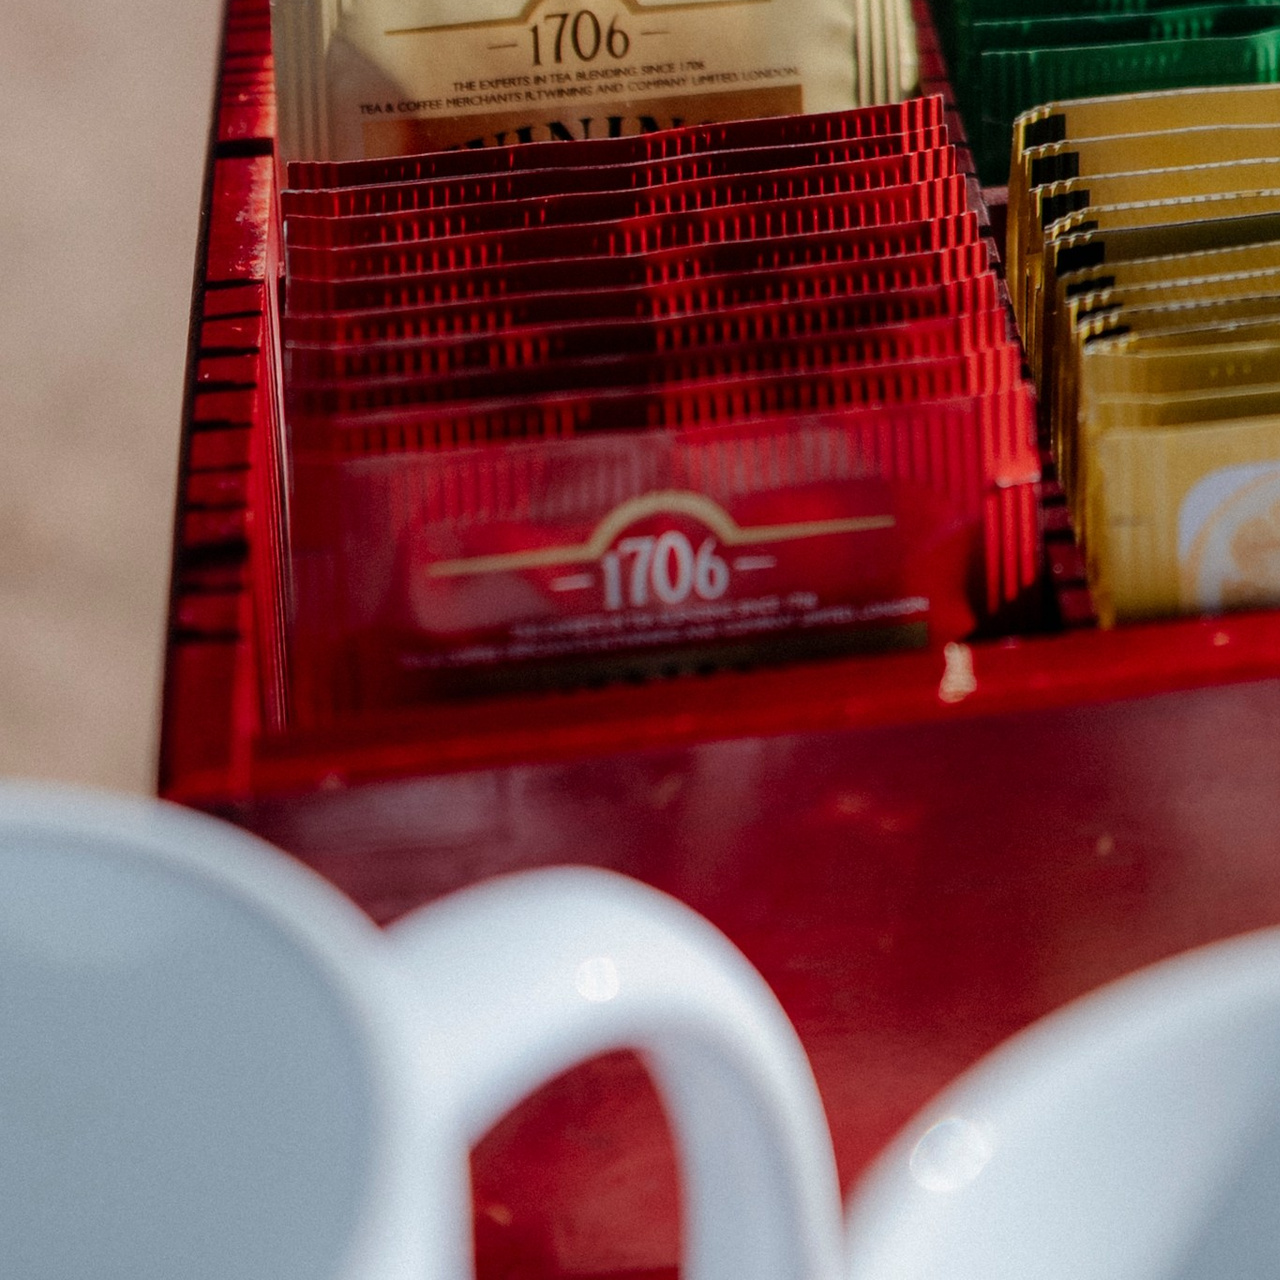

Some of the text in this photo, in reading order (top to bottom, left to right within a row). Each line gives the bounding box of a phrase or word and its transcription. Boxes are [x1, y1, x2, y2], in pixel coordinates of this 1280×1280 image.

[529, 9, 630, 66] 1706
[360, 104, 382, 115] TEA
[385, 103, 394, 113] &
[397, 99, 442, 113] COFFEE
[446, 92, 521, 108] MERCHANTS
[597, 83, 623, 96] AND
[628, 77, 687, 92] COMPANY
[453, 81, 476, 91] THE
[479, 76, 530, 91] EXPERTS
[534, 75, 547, 86] IN
[551, 72, 572, 84] TEA
[576, 65, 639, 80] BLENDING
[641, 62, 675, 75] SINCE
[603, 530, 731, 610] 1706
